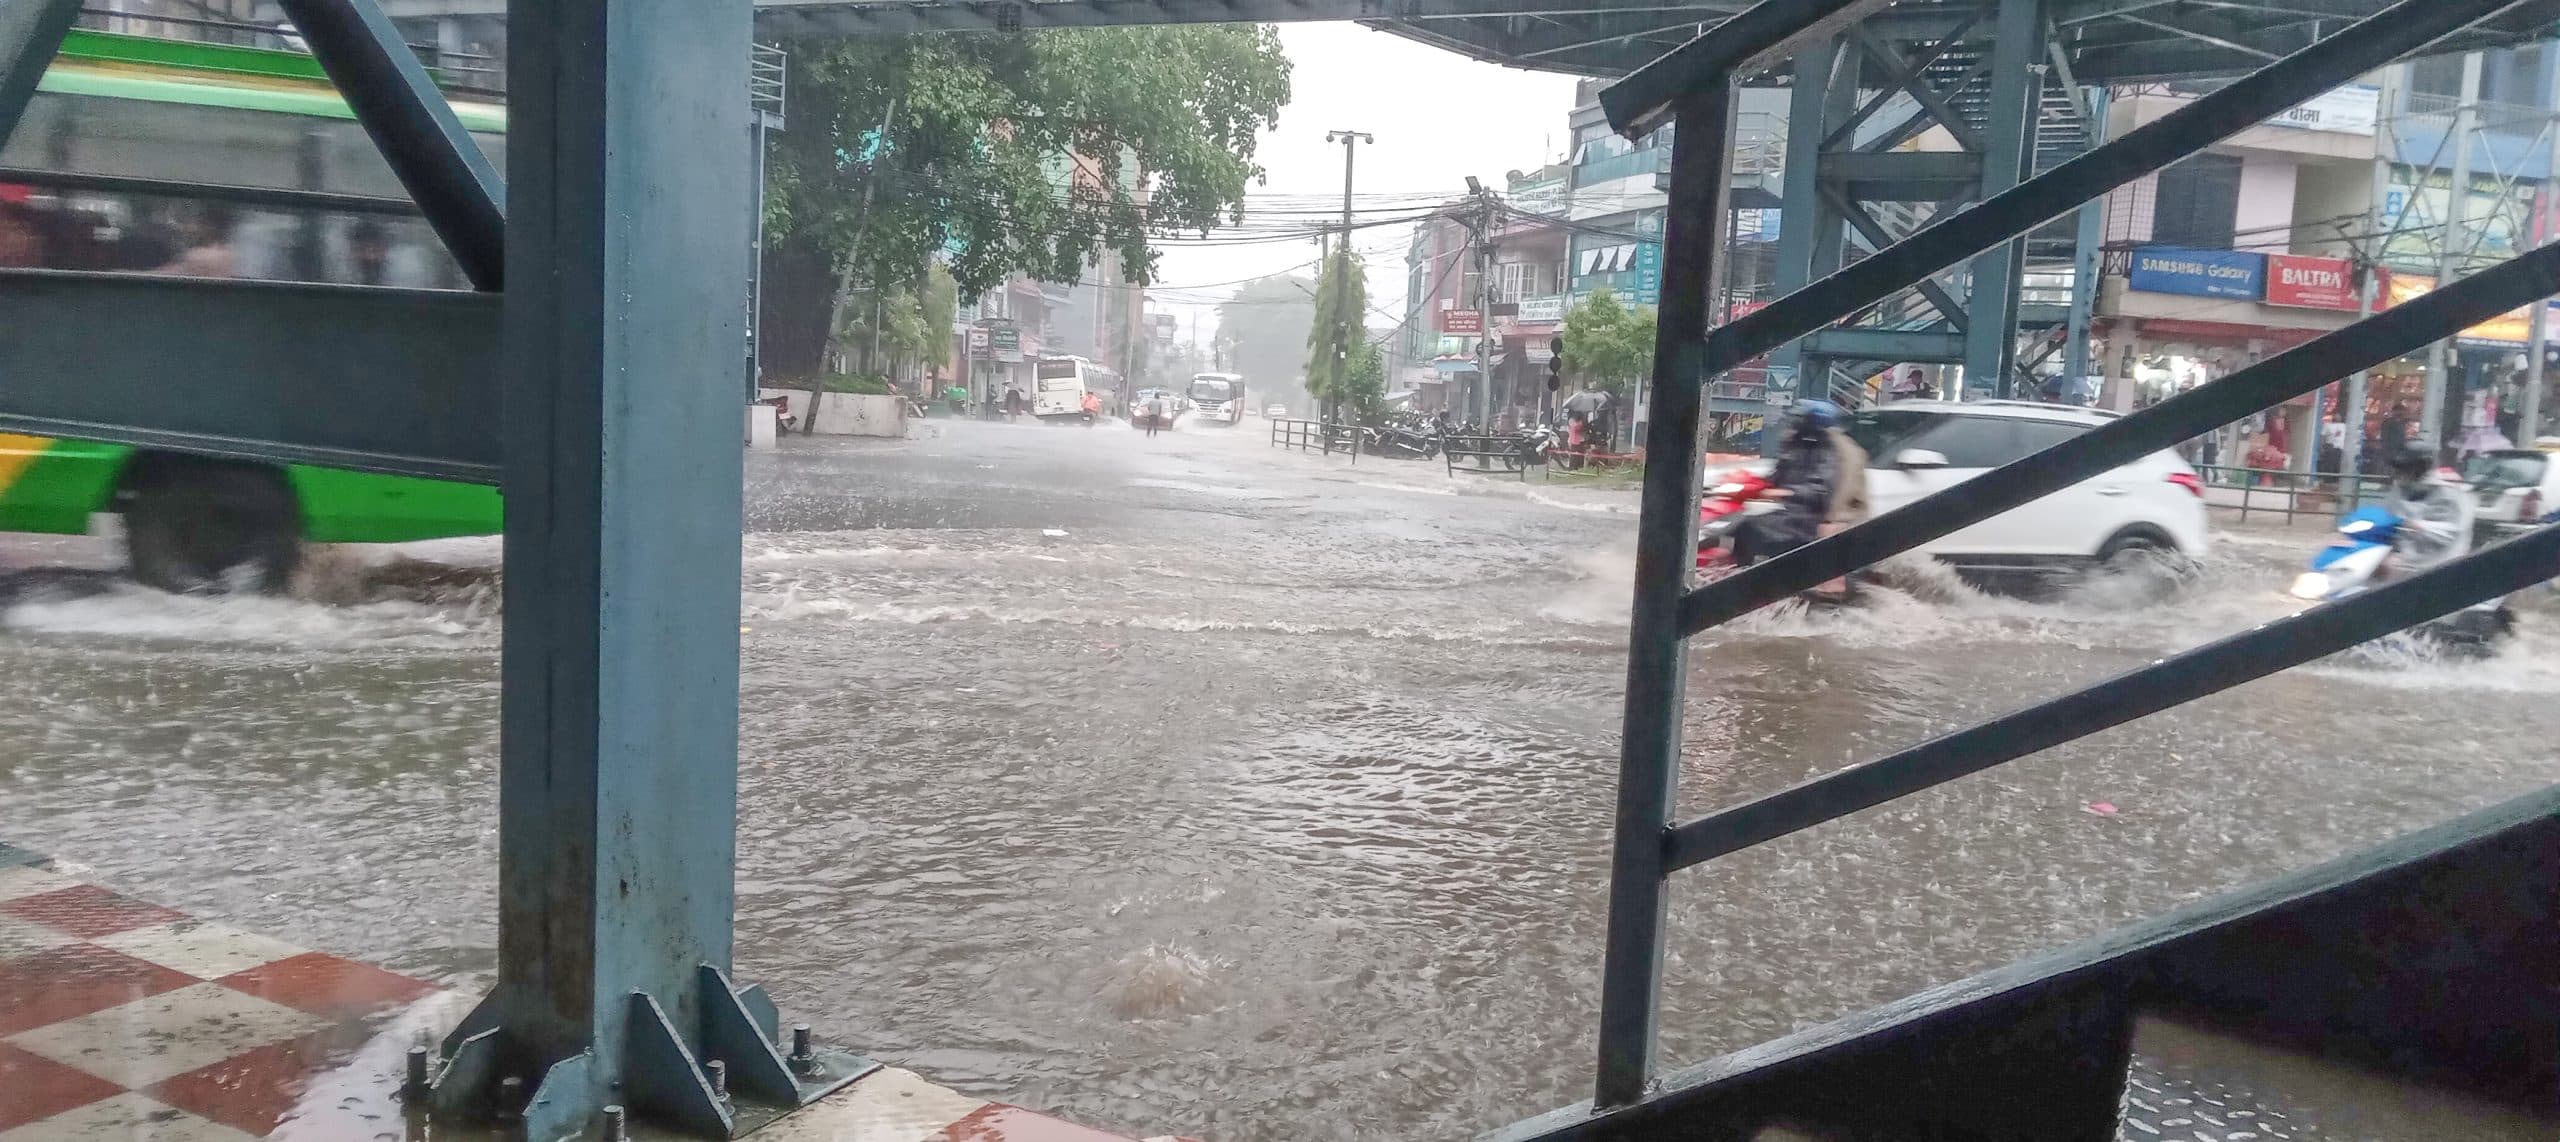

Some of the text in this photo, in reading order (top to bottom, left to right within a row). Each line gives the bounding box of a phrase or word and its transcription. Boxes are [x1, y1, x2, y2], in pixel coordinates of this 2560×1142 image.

[2142, 258, 2252, 283] SAMSUNG Galaxy
[2282, 267, 2342, 289] BALTRA
